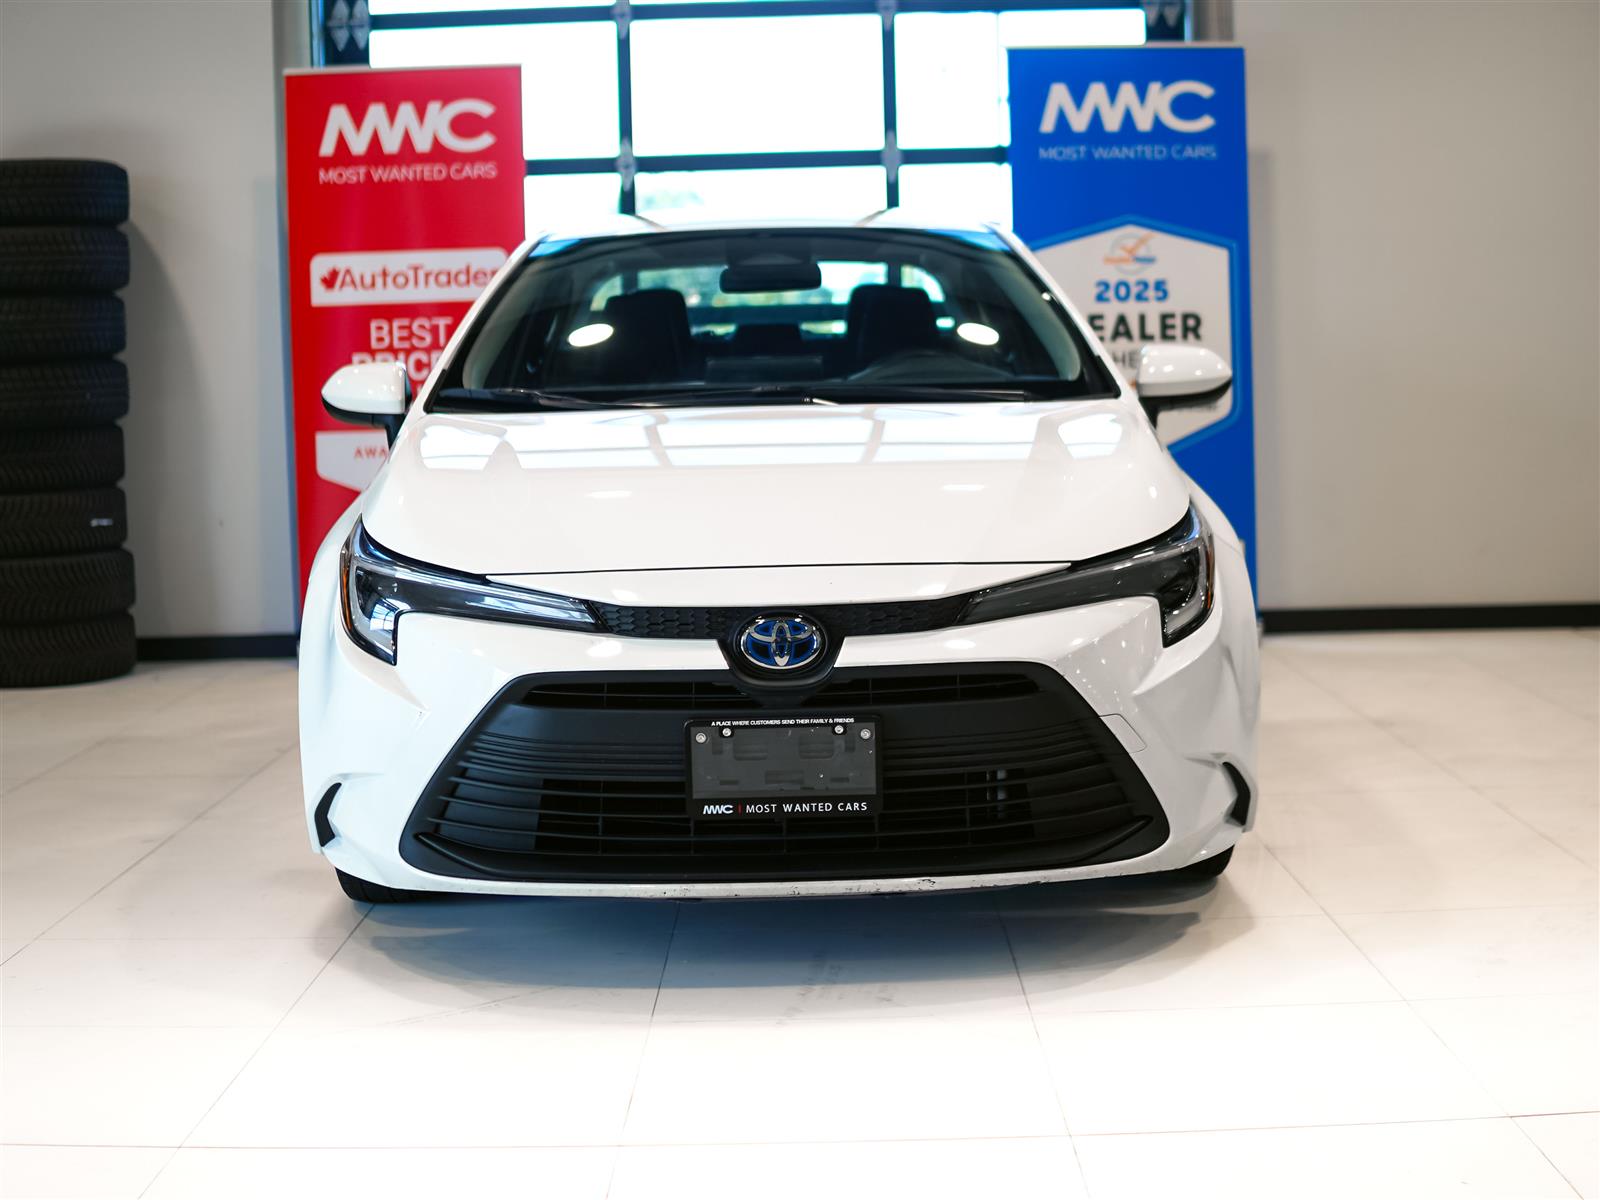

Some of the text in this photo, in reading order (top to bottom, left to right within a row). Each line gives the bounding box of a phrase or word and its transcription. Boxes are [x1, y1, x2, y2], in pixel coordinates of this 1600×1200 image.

[1038, 80, 1216, 134] MWC
[318, 98, 496, 157] MWC
[1038, 143, 1217, 161] MOST WANTED CARS
[318, 161, 498, 185] MOST WANTED CARS
[1095, 280, 1169, 302] 2025
[369, 317, 453, 350] BEST
[1088, 313, 1202, 342] EALER
[702, 802, 868, 815] MWC MOST WANTED CARS
